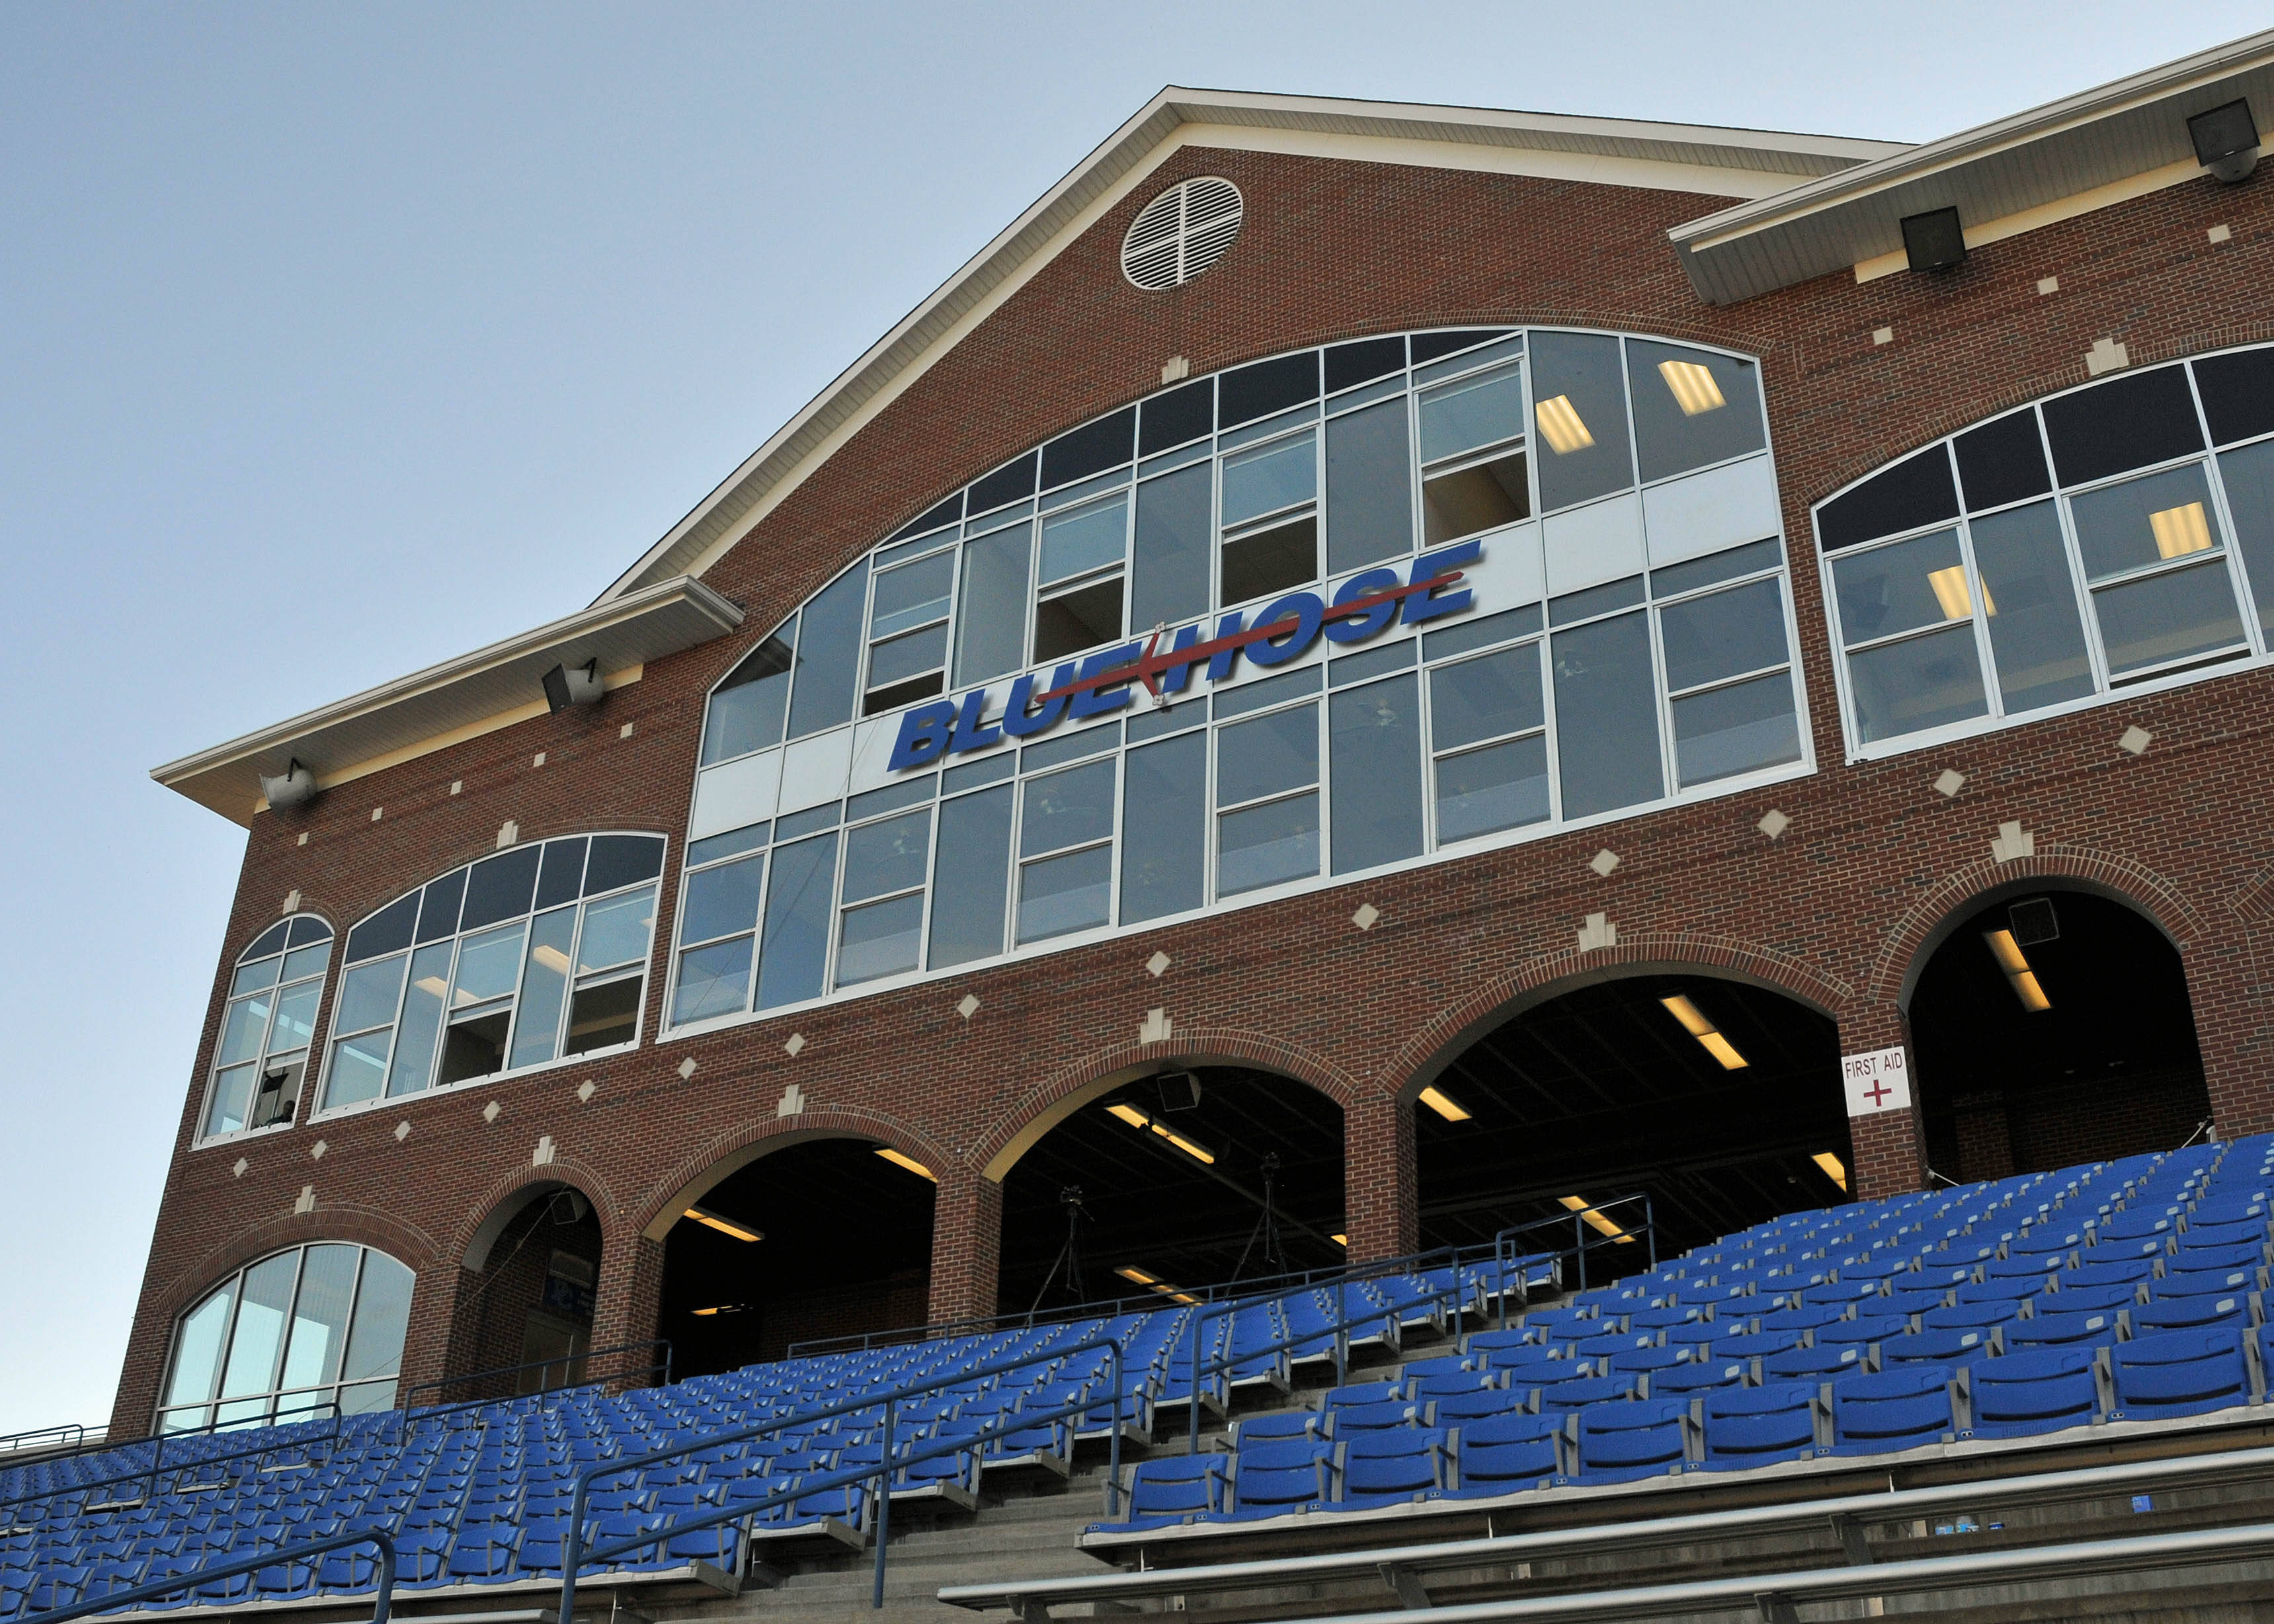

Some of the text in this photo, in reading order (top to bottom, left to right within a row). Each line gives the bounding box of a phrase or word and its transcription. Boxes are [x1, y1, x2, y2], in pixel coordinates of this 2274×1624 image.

[887, 540, 1481, 772] BLUE HOSE
[1845, 1052, 1902, 1078] FIRST AID
